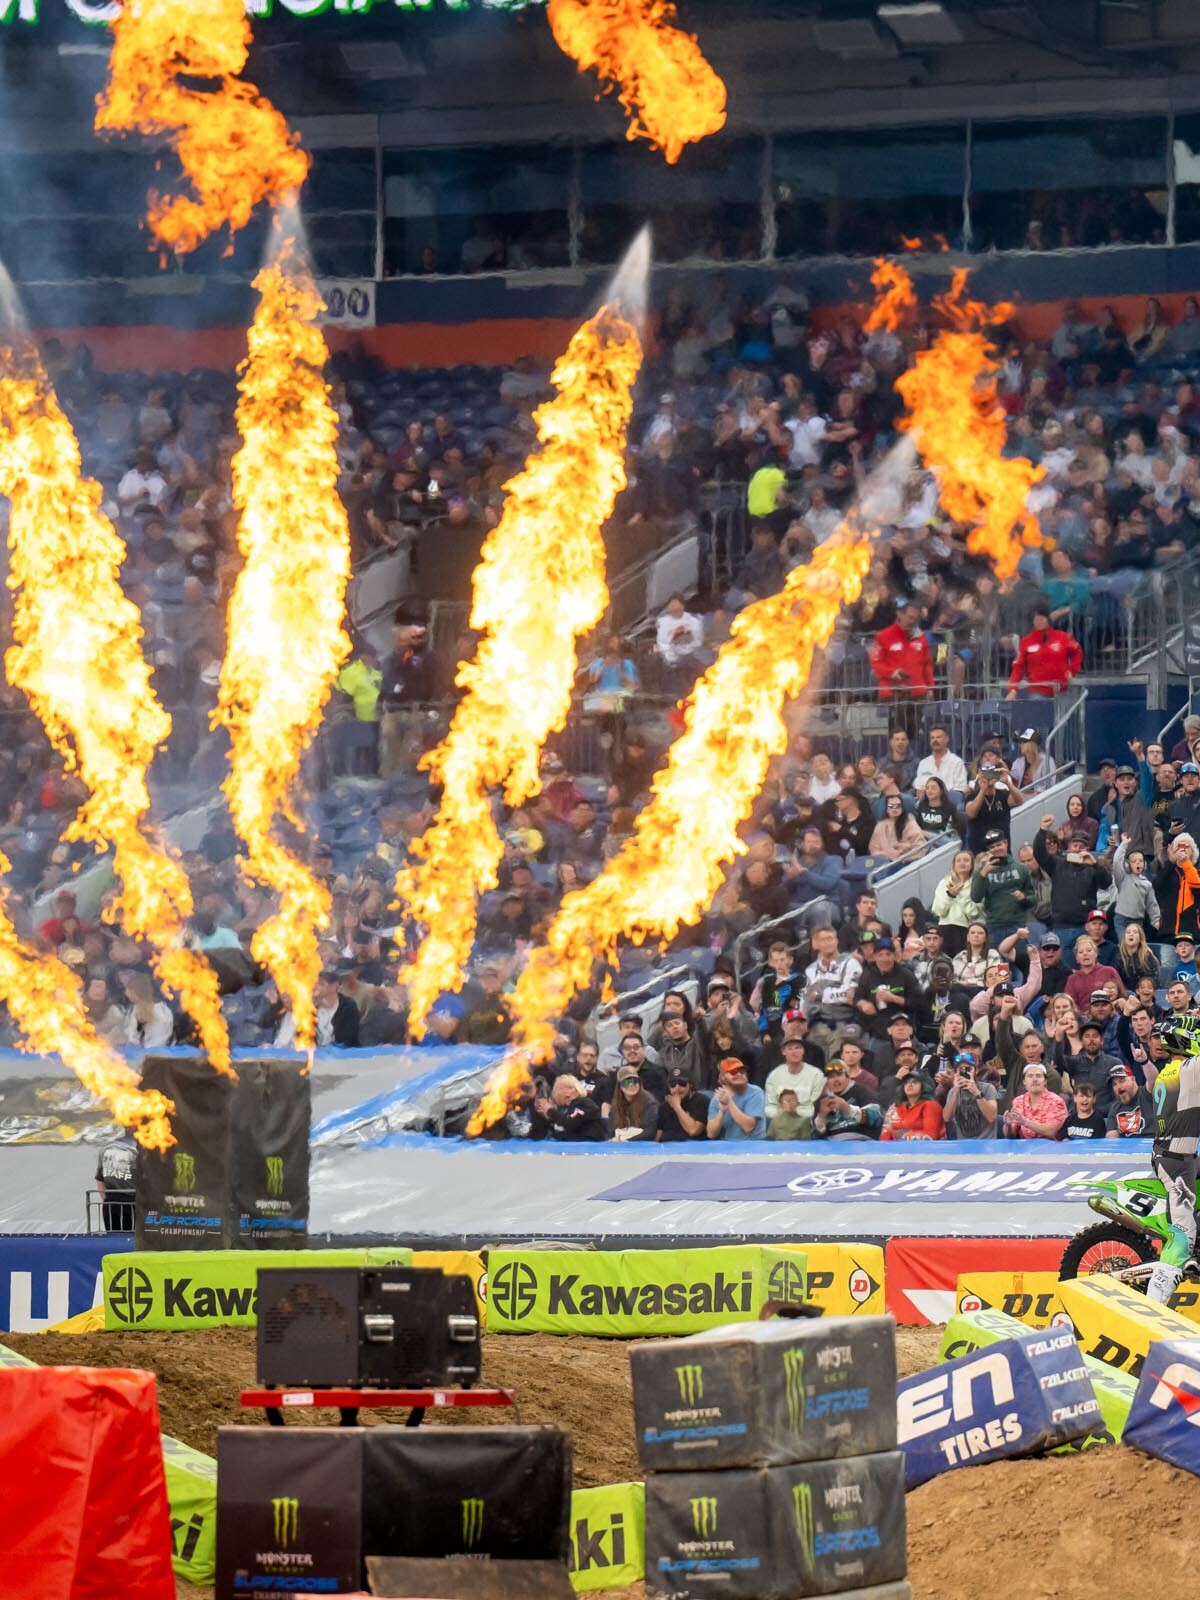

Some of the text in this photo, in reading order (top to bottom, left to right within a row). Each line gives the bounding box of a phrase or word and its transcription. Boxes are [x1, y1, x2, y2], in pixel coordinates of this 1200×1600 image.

[327, 287, 369, 318] 00
[872, 1169, 1153, 1191] YAMAH
[1126, 1193, 1158, 1217] 9
[548, 1271, 752, 1316] Kawasaki
[1026, 1334, 1078, 1357] FALKEN
[1040, 1366, 1090, 1390] FALKEN
[1051, 1400, 1100, 1422] FALKEN
[938, 1412, 1024, 1467] TIRES
[256, 1552, 314, 1567] MONSTER
